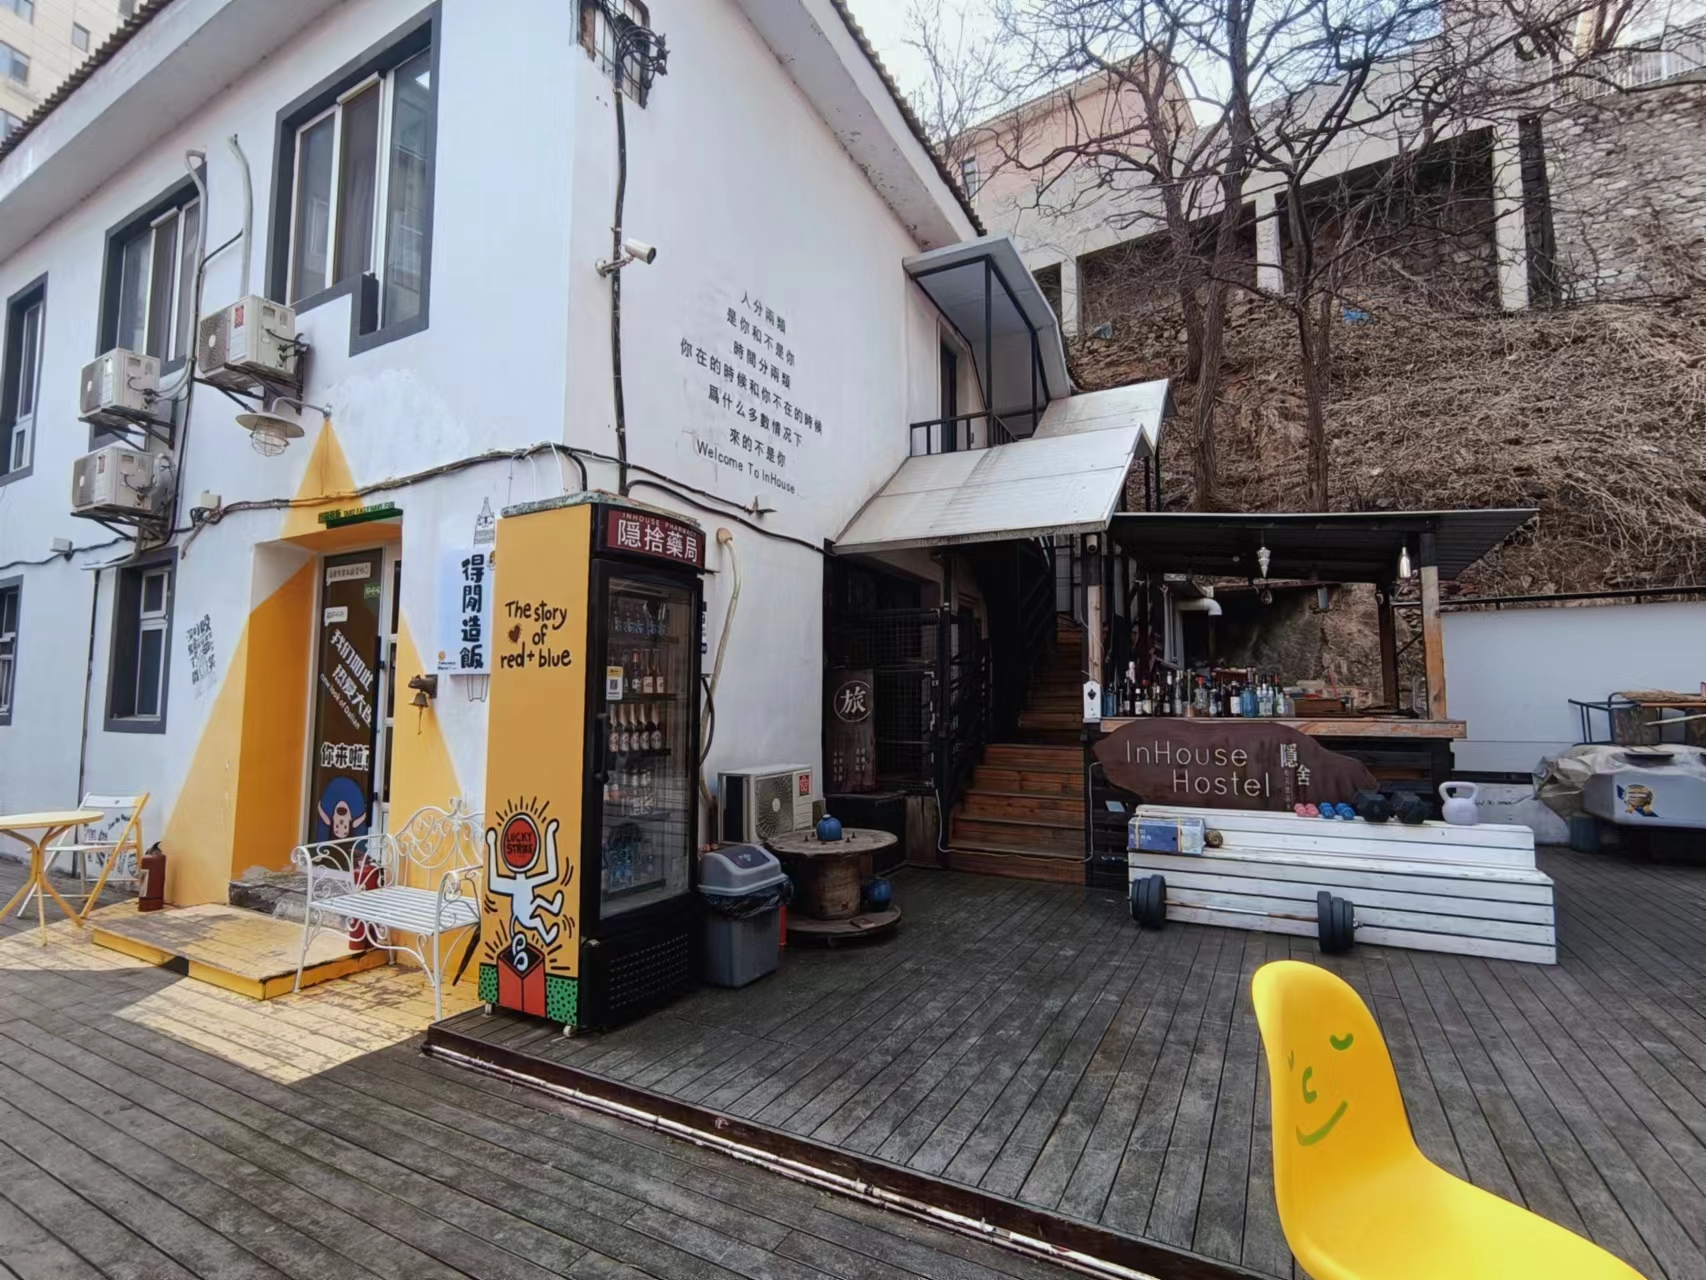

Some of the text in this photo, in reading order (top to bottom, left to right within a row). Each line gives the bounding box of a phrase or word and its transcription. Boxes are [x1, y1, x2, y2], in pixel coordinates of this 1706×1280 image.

[727, 307, 795, 367] 是你和不是你
[680, 337, 823, 436] 你在的時候和你不在的時候
[697, 439, 743, 472] Welcome
[748, 462, 760, 479] To
[729, 428, 786, 468] 來的不是你
[622, 512, 698, 538] INHOUSE PHARMACY
[505, 600, 568, 631] The story
[532, 623, 548, 646] of
[330, 628, 374, 692] 我们如此
[320, 672, 331, 688] new
[344, 703, 360, 729] Dalian
[840, 686, 867, 714] 旅
[1126, 740, 1248, 767] InHouse
[1172, 769, 1271, 797] Hostel
[506, 831, 533, 842] LUCKY
[506, 843, 534, 855] STRIKE
